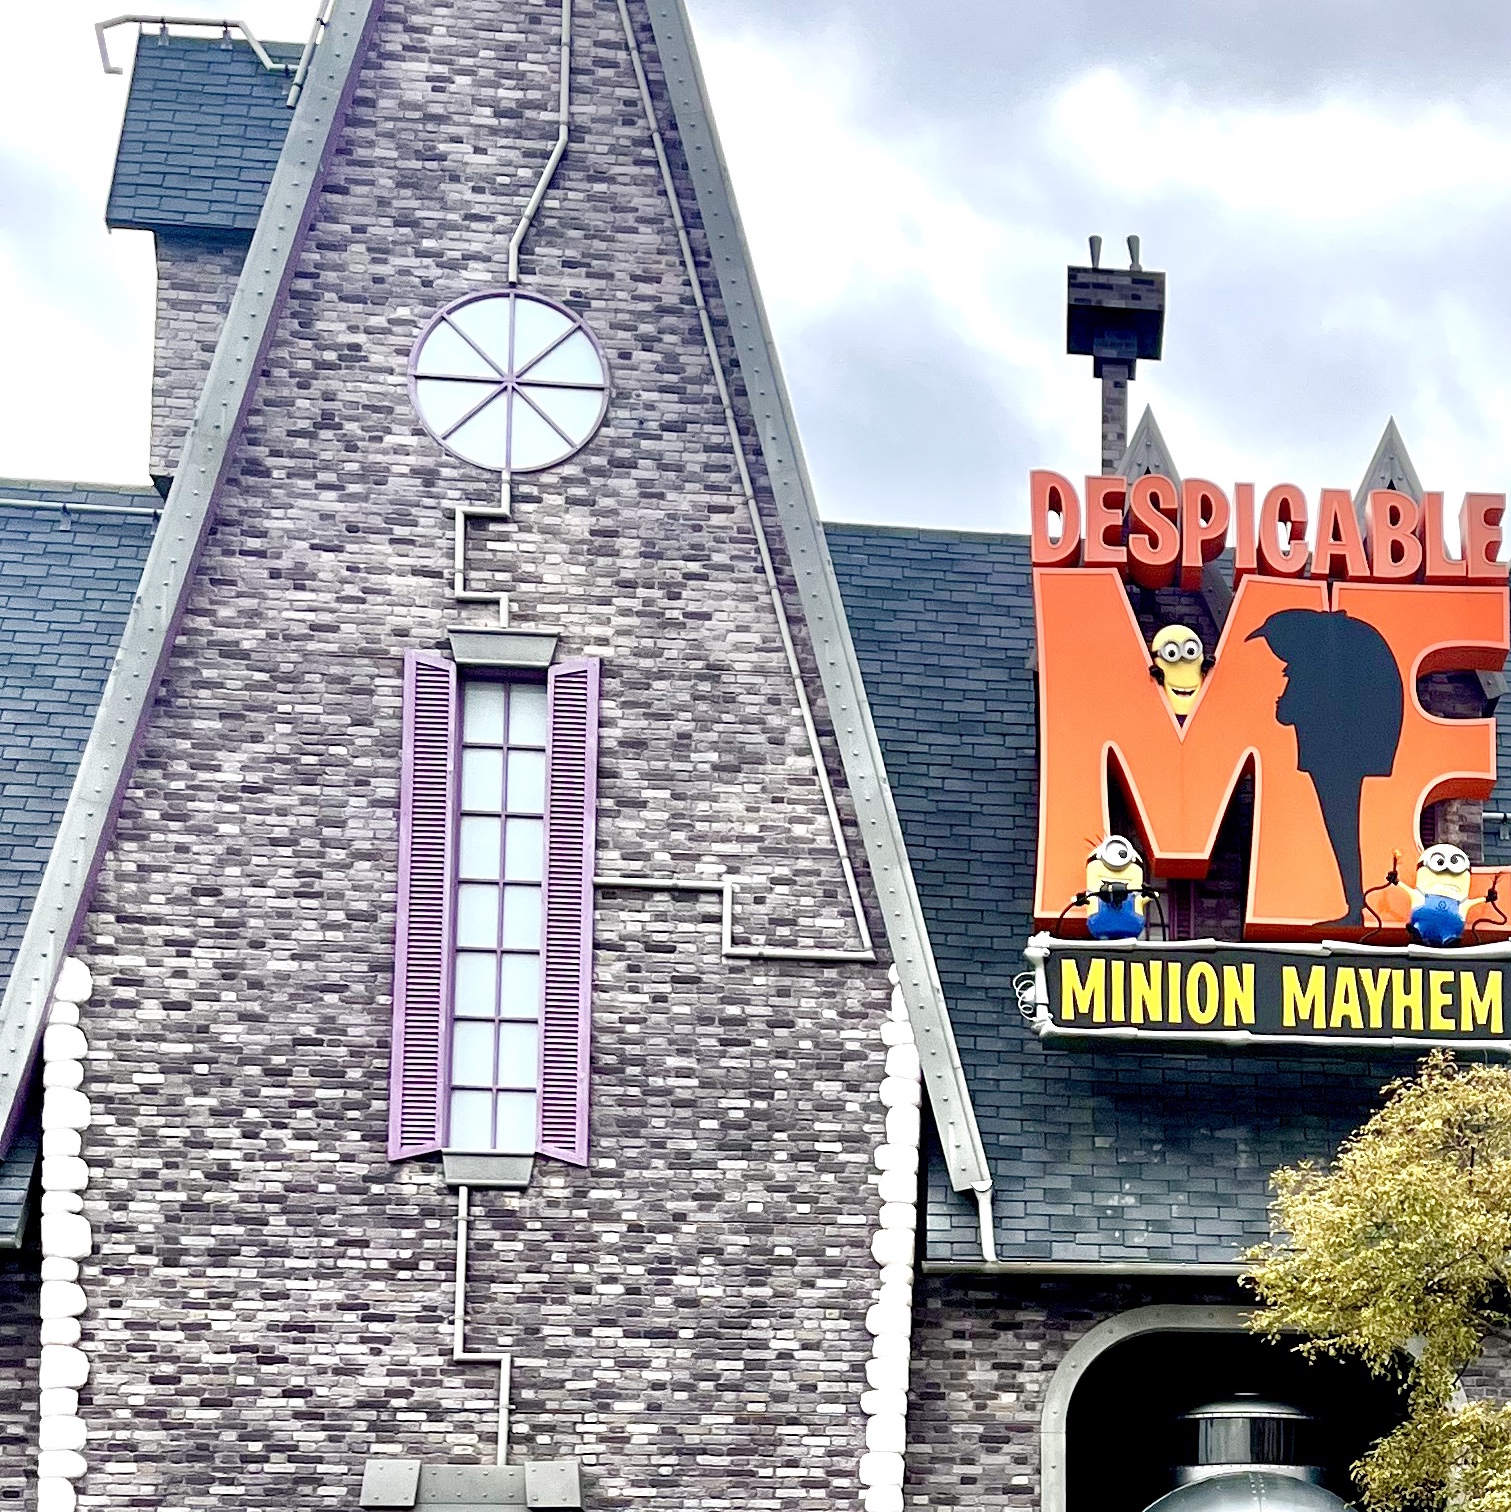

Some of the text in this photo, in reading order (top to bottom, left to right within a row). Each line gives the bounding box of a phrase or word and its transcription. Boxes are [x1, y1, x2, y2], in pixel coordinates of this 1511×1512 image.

[1030, 470, 1509, 590] DESPICABLE
[1060, 958, 1504, 1034] MINION MAYHEM
